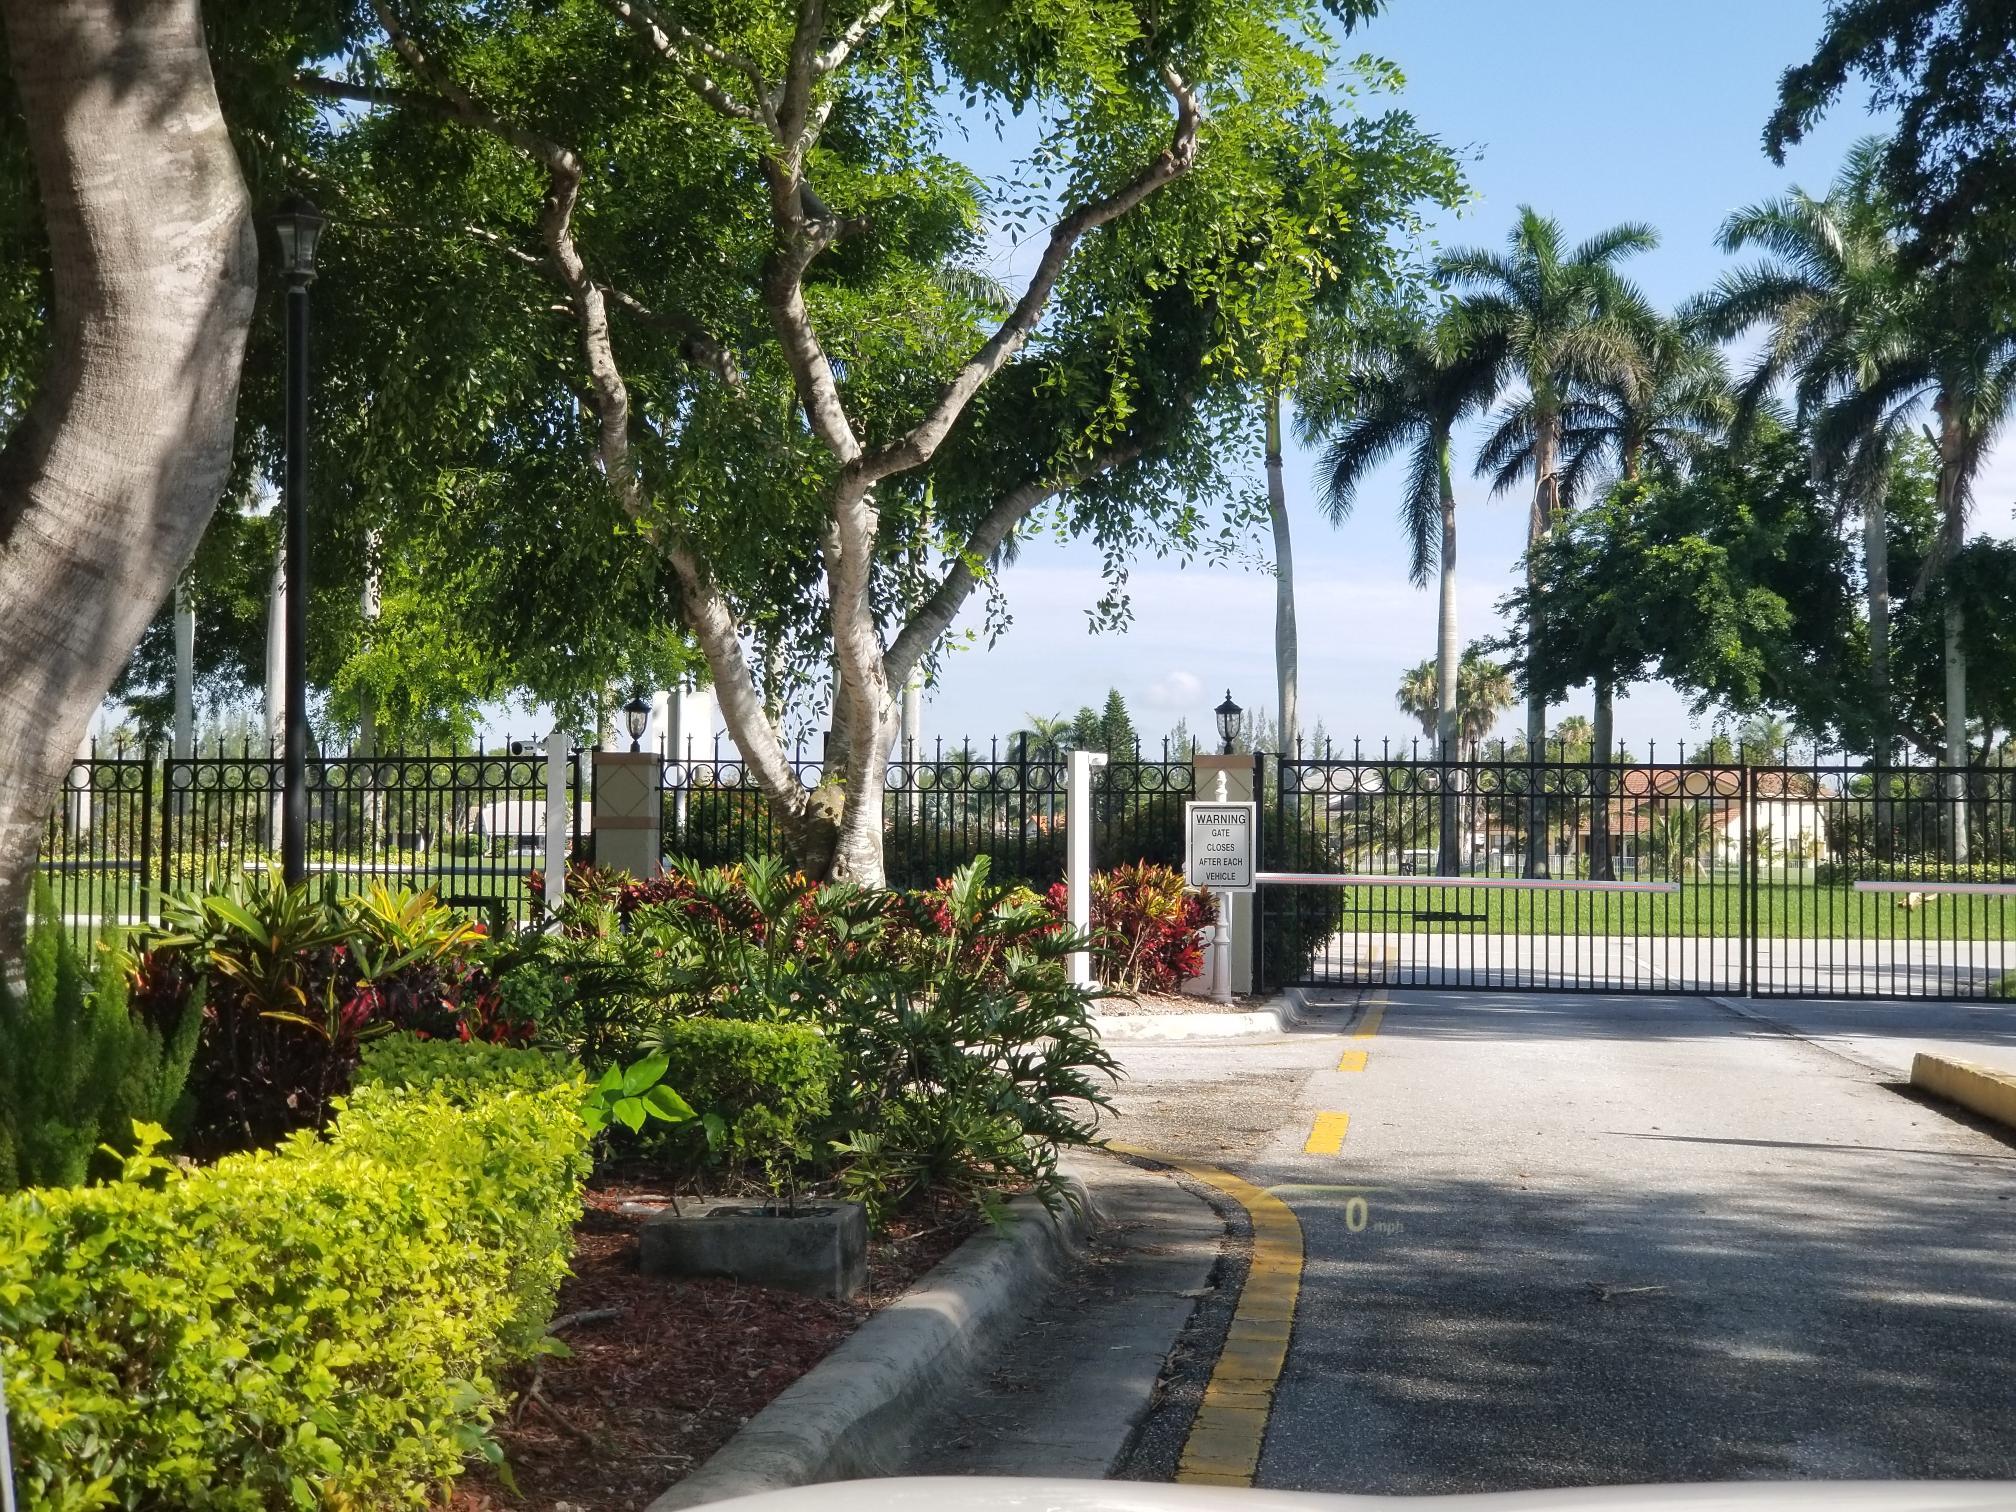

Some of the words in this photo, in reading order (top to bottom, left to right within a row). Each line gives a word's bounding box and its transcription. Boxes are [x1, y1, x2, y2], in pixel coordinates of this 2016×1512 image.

[1196, 814, 1246, 824] WARNING
[1211, 828, 1230, 837] GATE
[1206, 843, 1235, 852] CLOSES
[1199, 857, 1222, 866] AFTER
[1223, 857, 1243, 866] EACH
[1205, 872, 1236, 881] VEHICLE
[1345, 1196, 1369, 1233] 0
